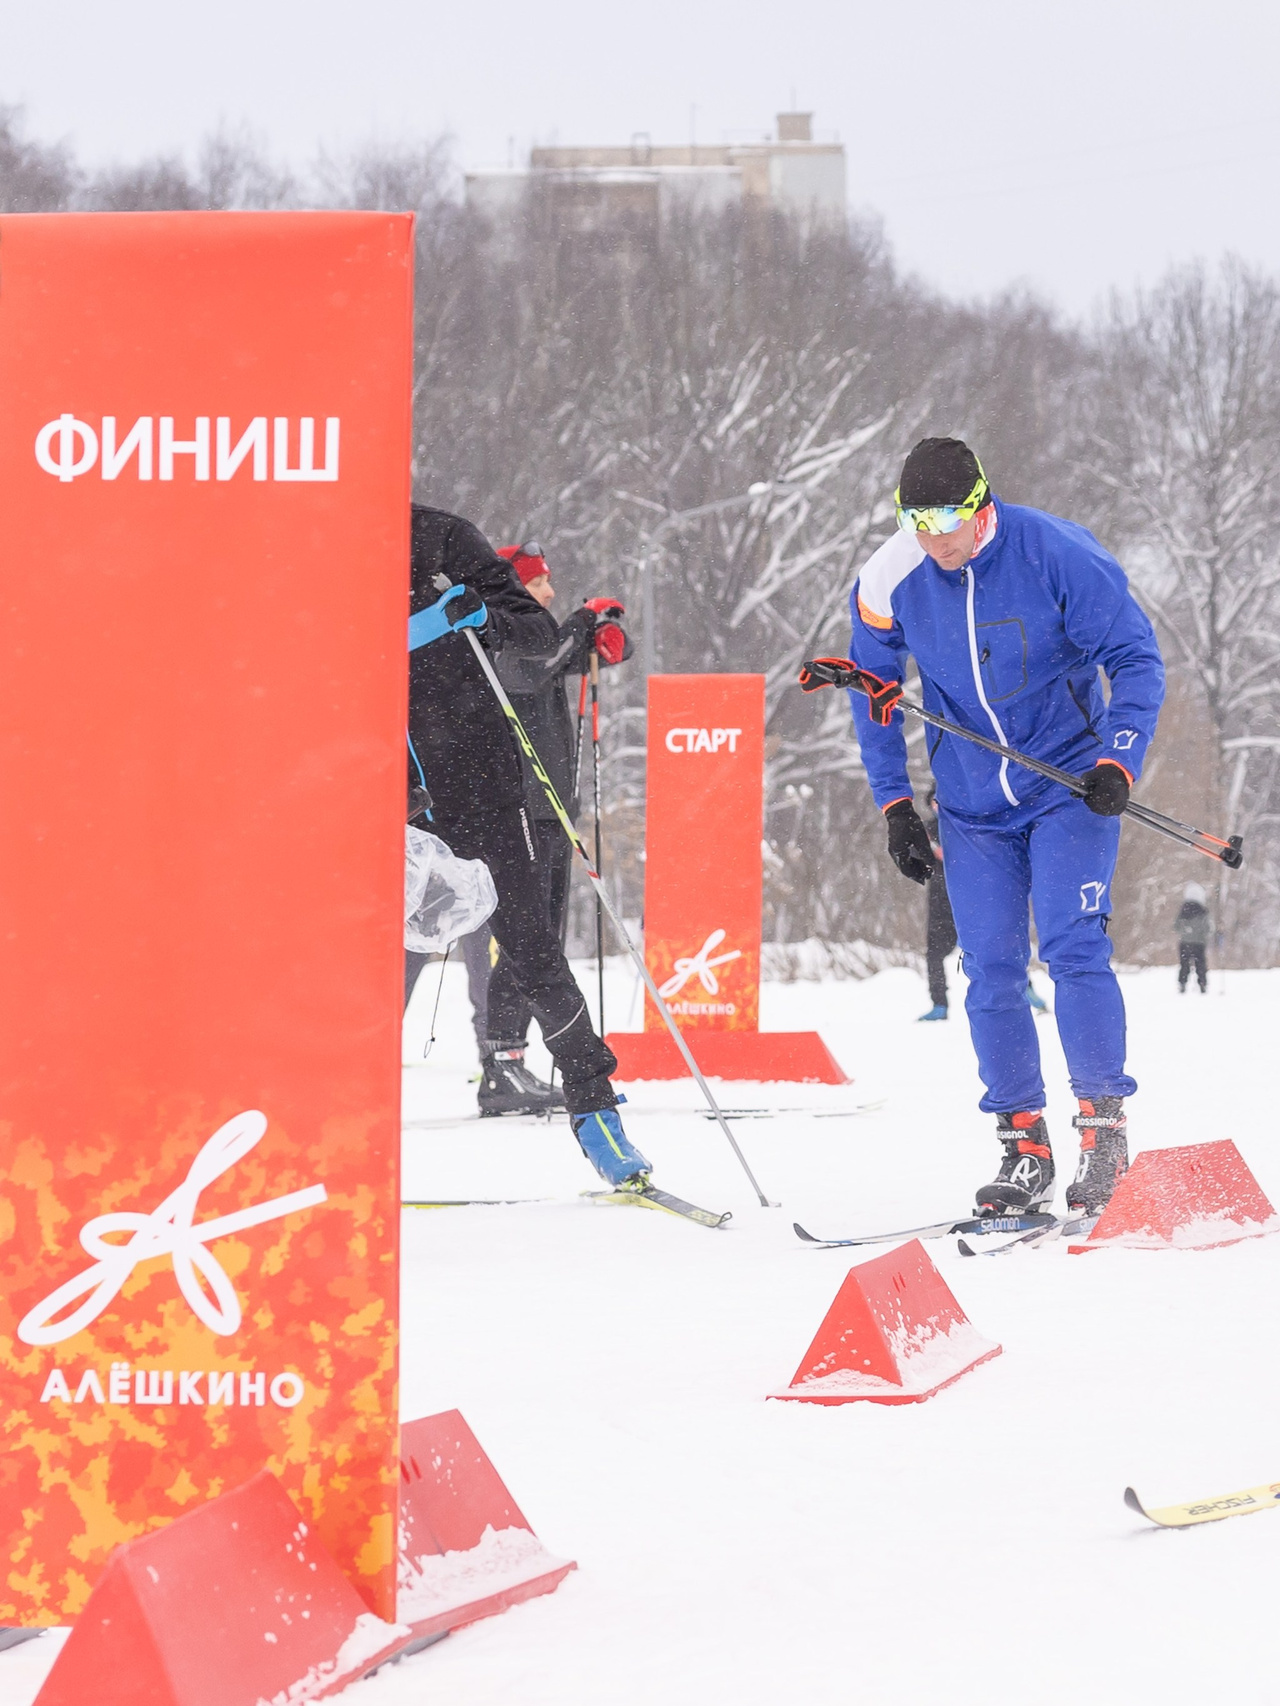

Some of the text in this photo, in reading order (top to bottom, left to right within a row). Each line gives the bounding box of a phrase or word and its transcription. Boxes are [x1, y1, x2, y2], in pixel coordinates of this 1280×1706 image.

[34, 413, 340, 482] ФИНИШ
[665, 728, 743, 753] СТАРТ
[518, 807, 536, 861] NORDSKI
[39, 1361, 305, 1408] АЛЁШКИНО
[1184, 1493, 1257, 1517] FISCHER
